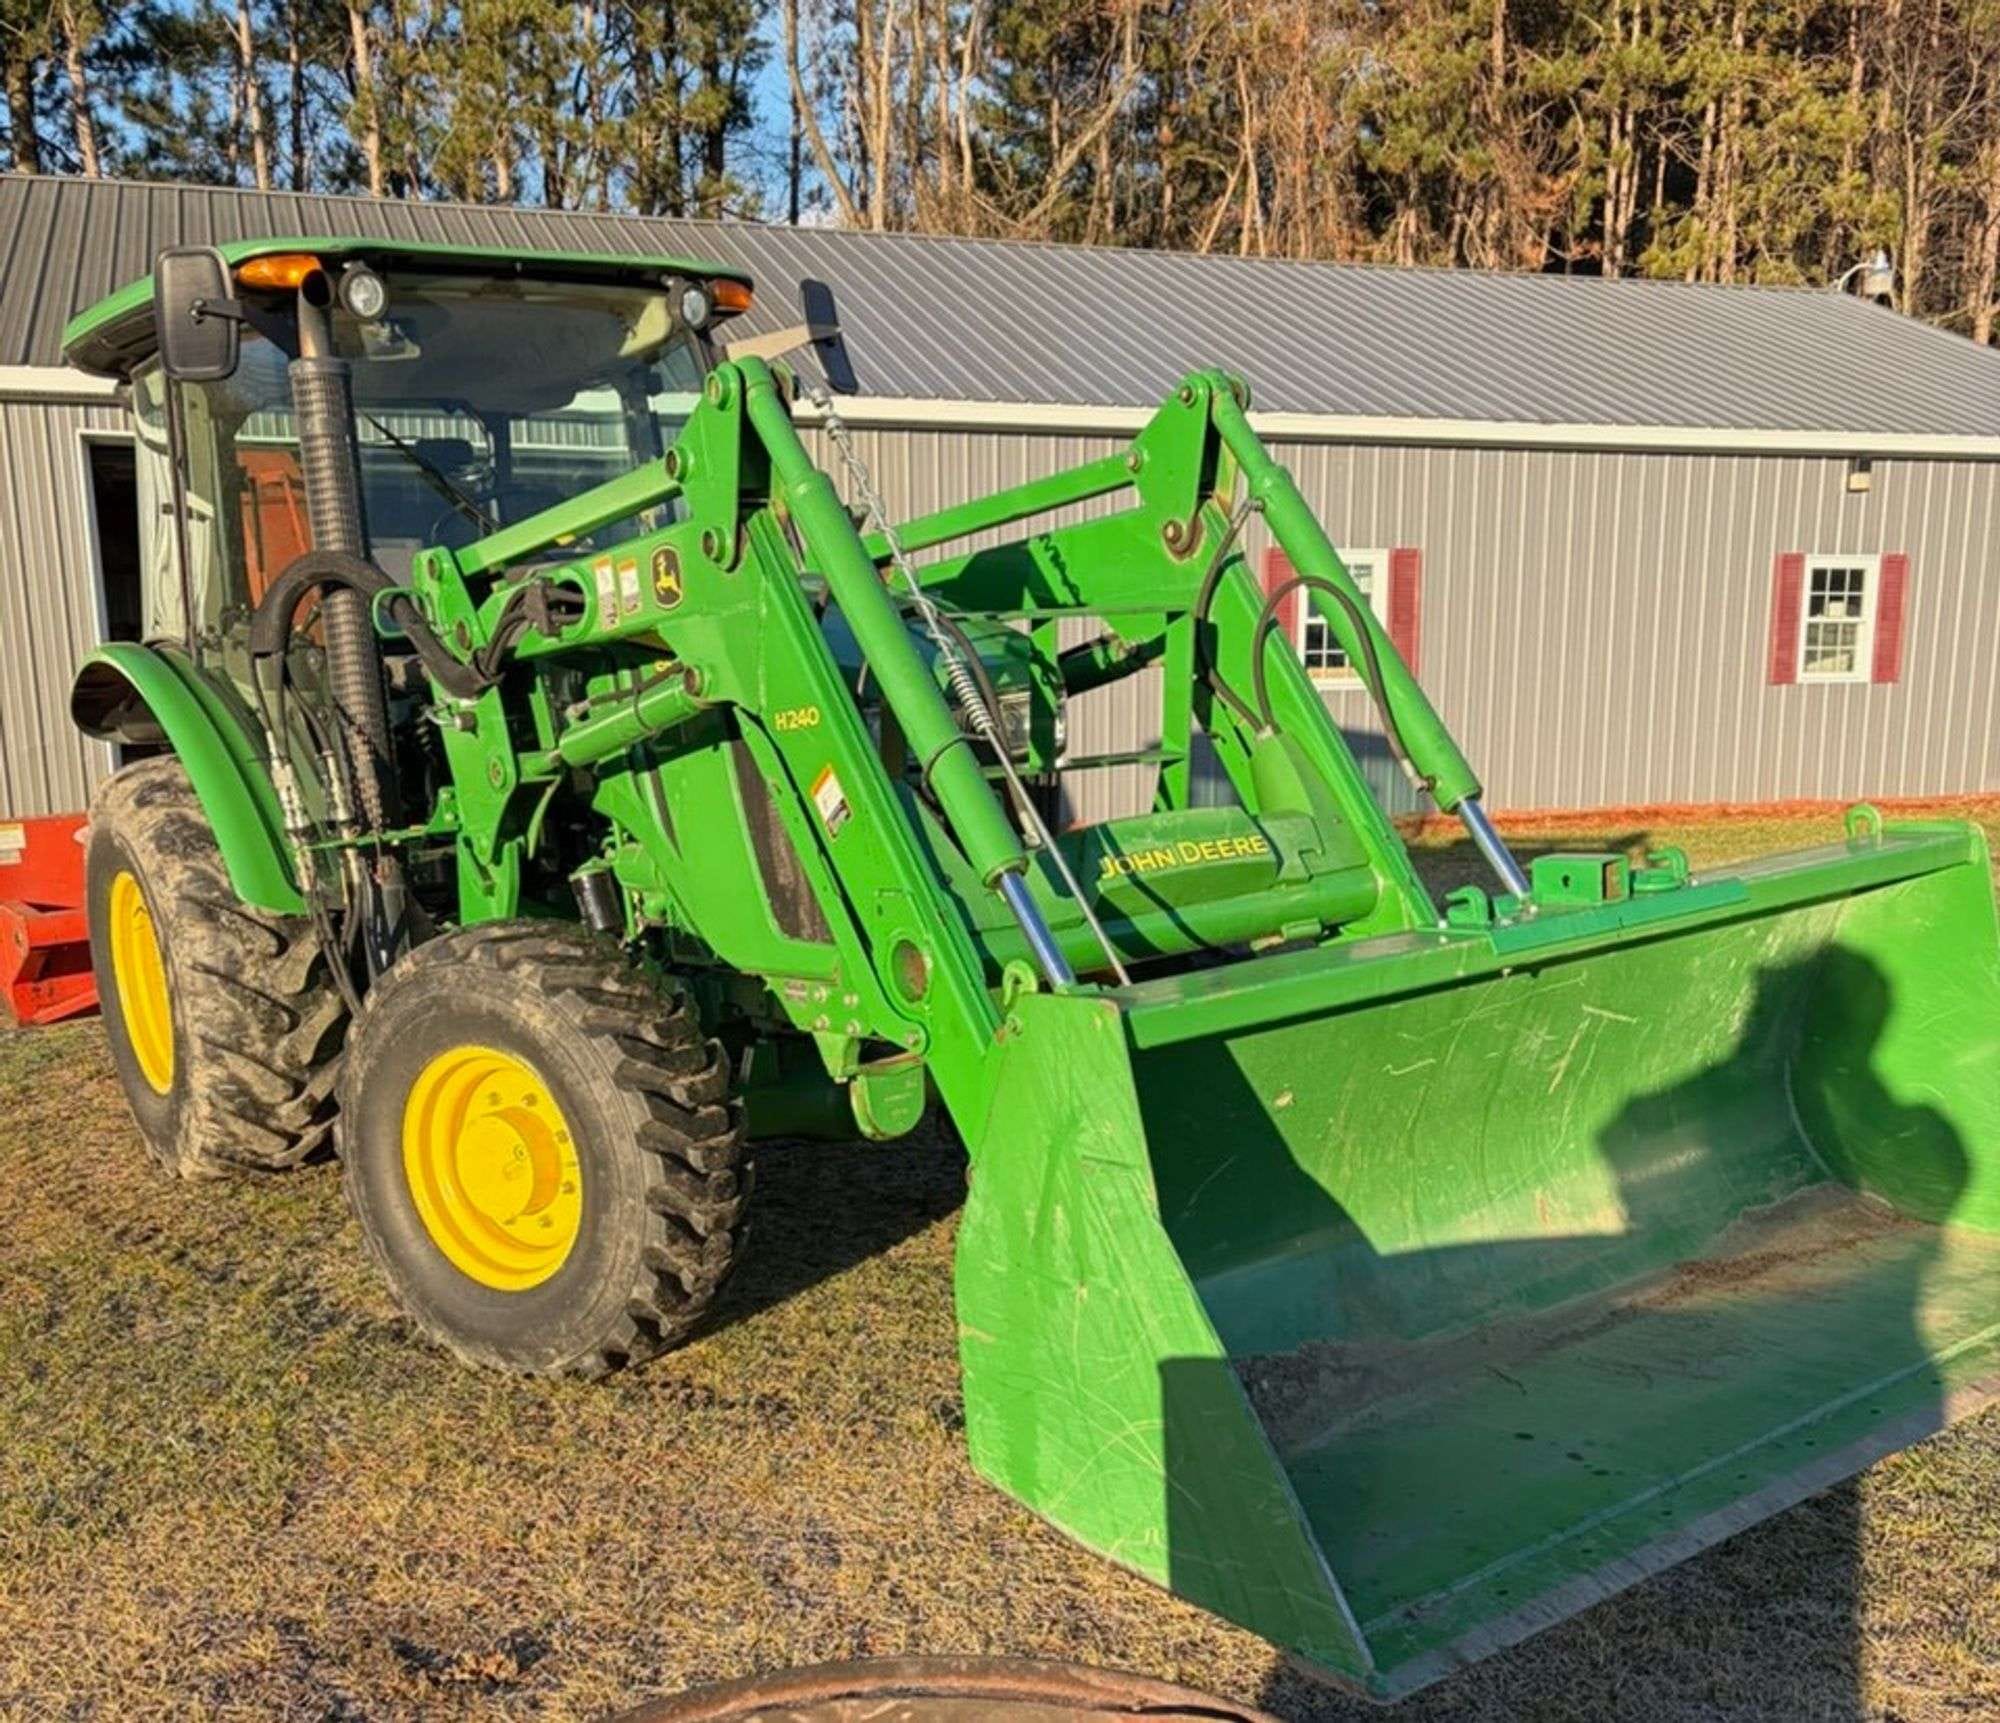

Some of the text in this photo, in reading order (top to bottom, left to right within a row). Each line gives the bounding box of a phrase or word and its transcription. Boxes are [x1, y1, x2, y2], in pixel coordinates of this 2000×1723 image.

[775, 706, 820, 730] H240
[1099, 835, 1269, 879] JOHN DEERE
